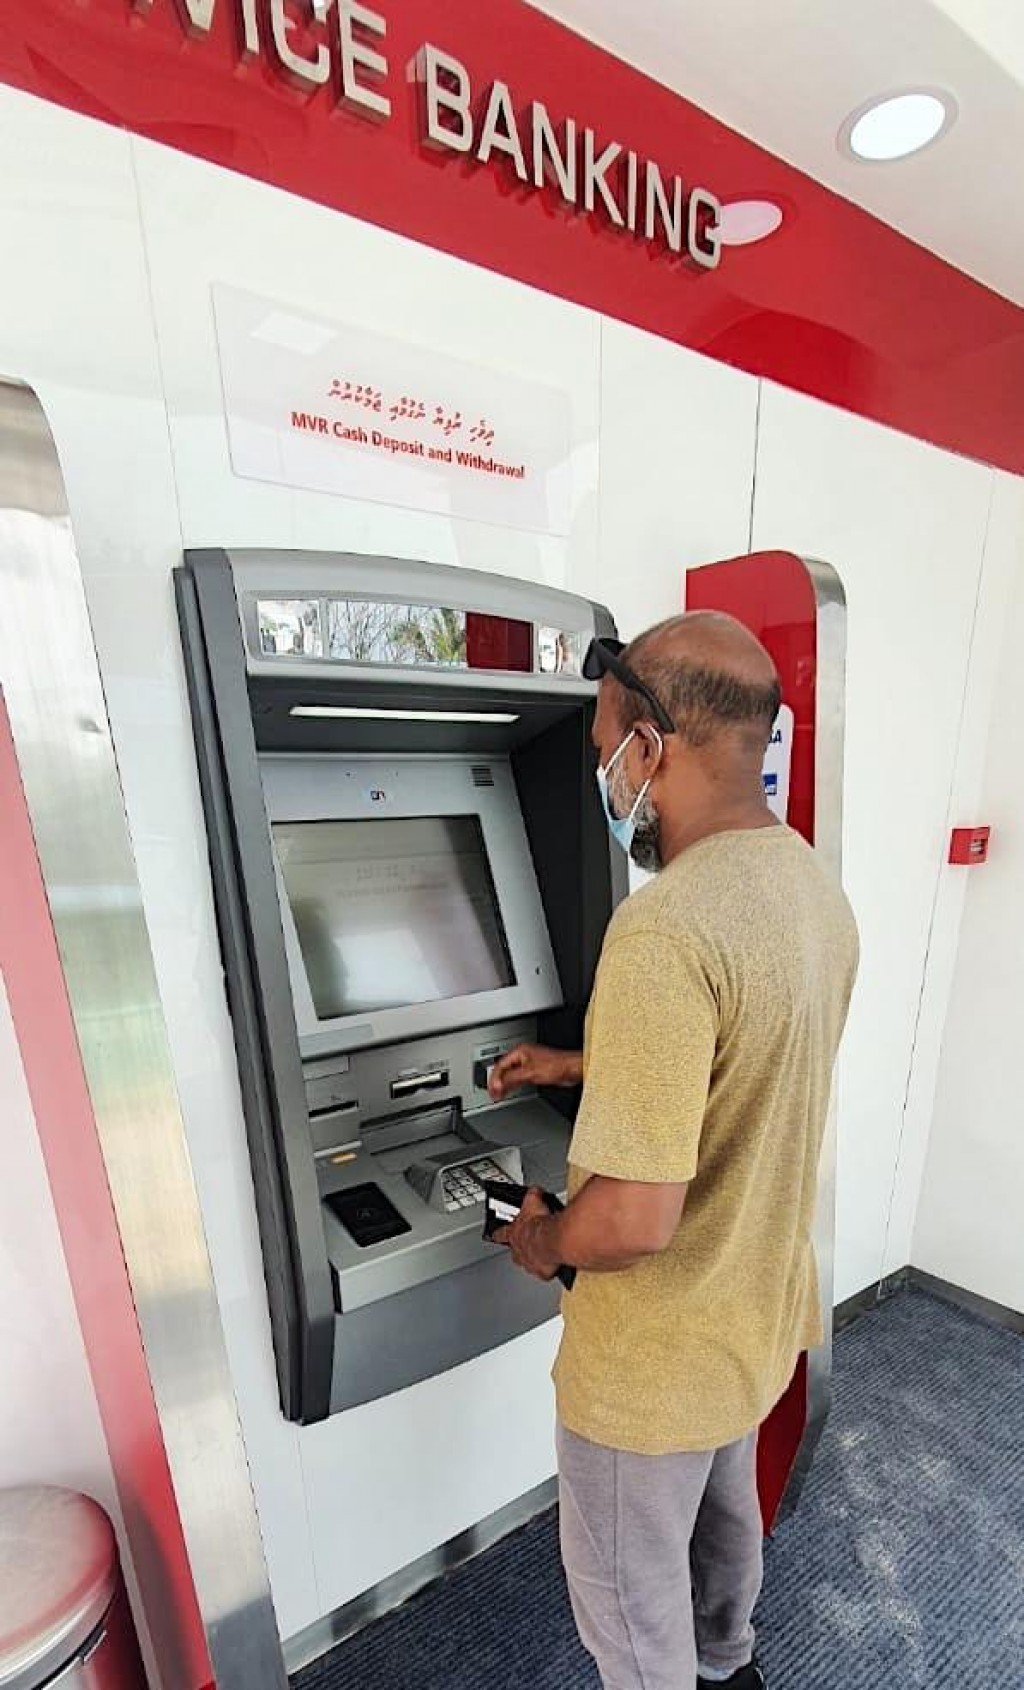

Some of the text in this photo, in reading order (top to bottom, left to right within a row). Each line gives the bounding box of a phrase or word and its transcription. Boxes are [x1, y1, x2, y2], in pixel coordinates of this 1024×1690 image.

[425, 44, 722, 270] BANKING
[290, 411, 526, 480] MVR Cash Deposit and Withdrawal
